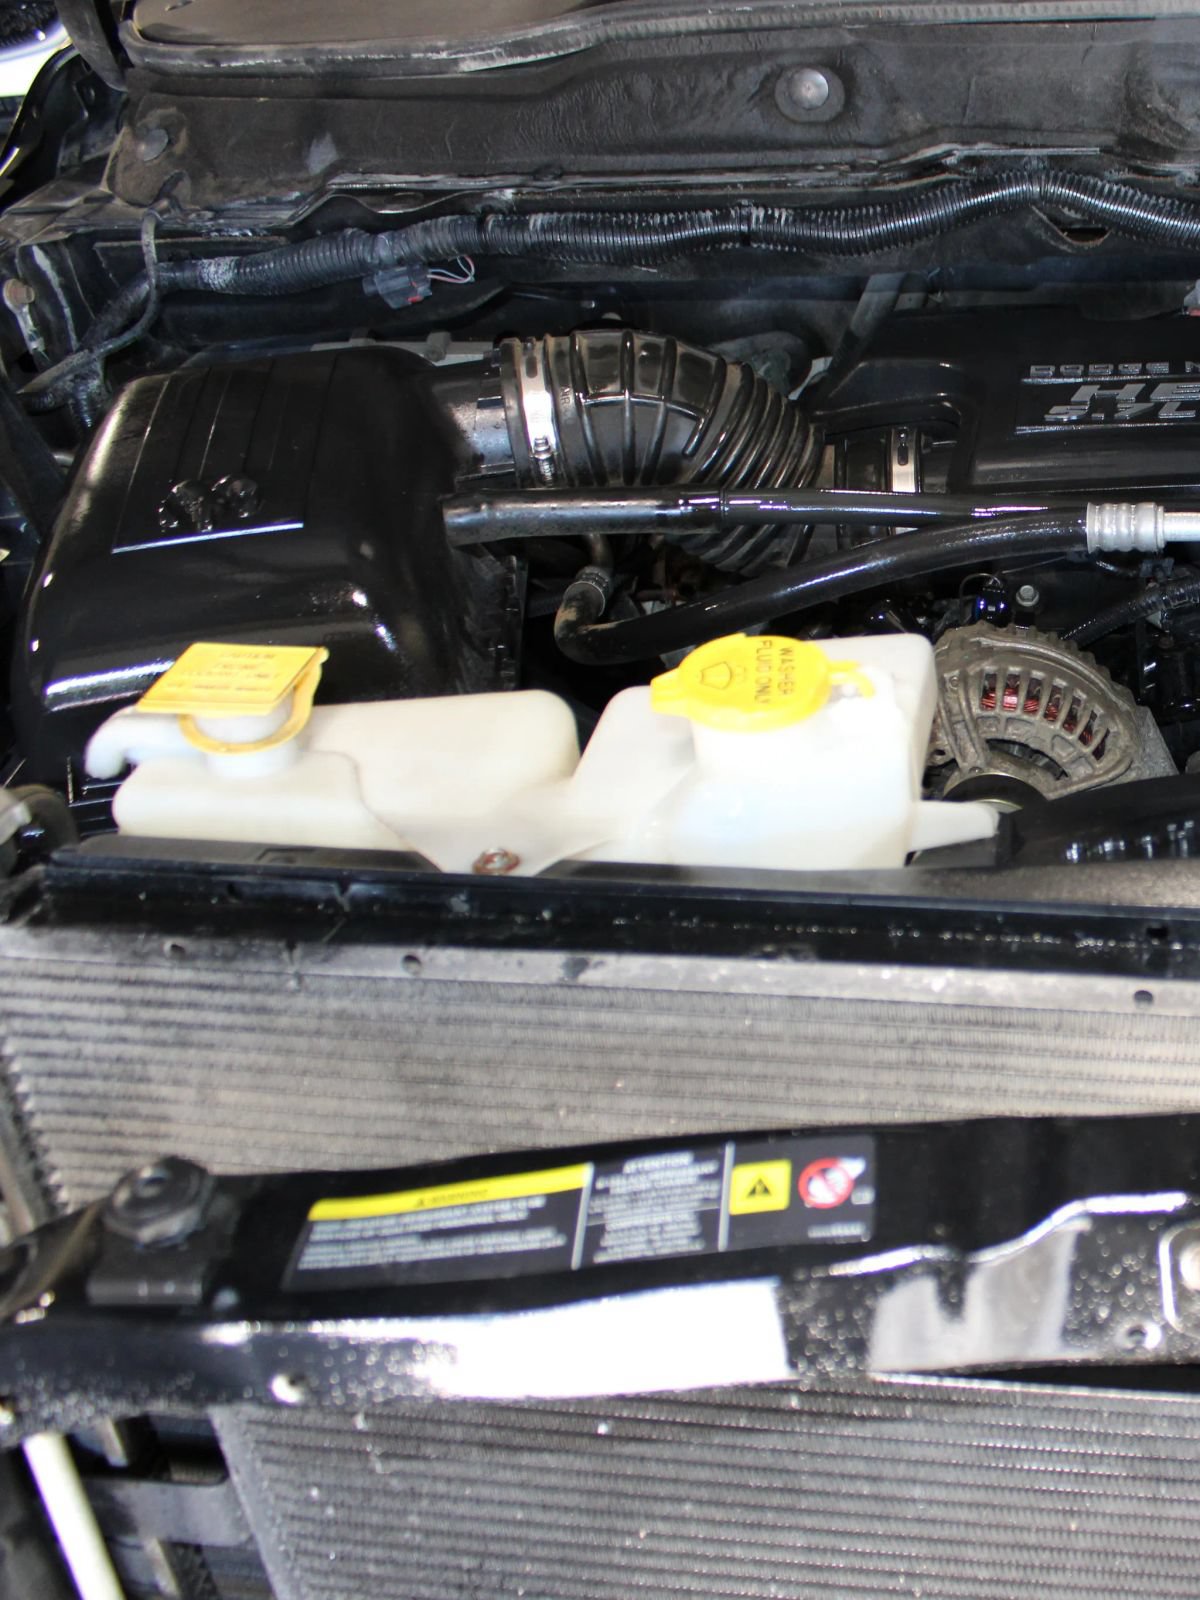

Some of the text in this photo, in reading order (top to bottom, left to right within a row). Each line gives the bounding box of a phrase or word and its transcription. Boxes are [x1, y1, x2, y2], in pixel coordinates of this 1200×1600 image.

[1030, 361, 1170, 378] DODGE
[1044, 401, 1197, 422] 5.7L
[754, 639, 773, 704] FLUID ONLY
[777, 646, 796, 696] WASHER
